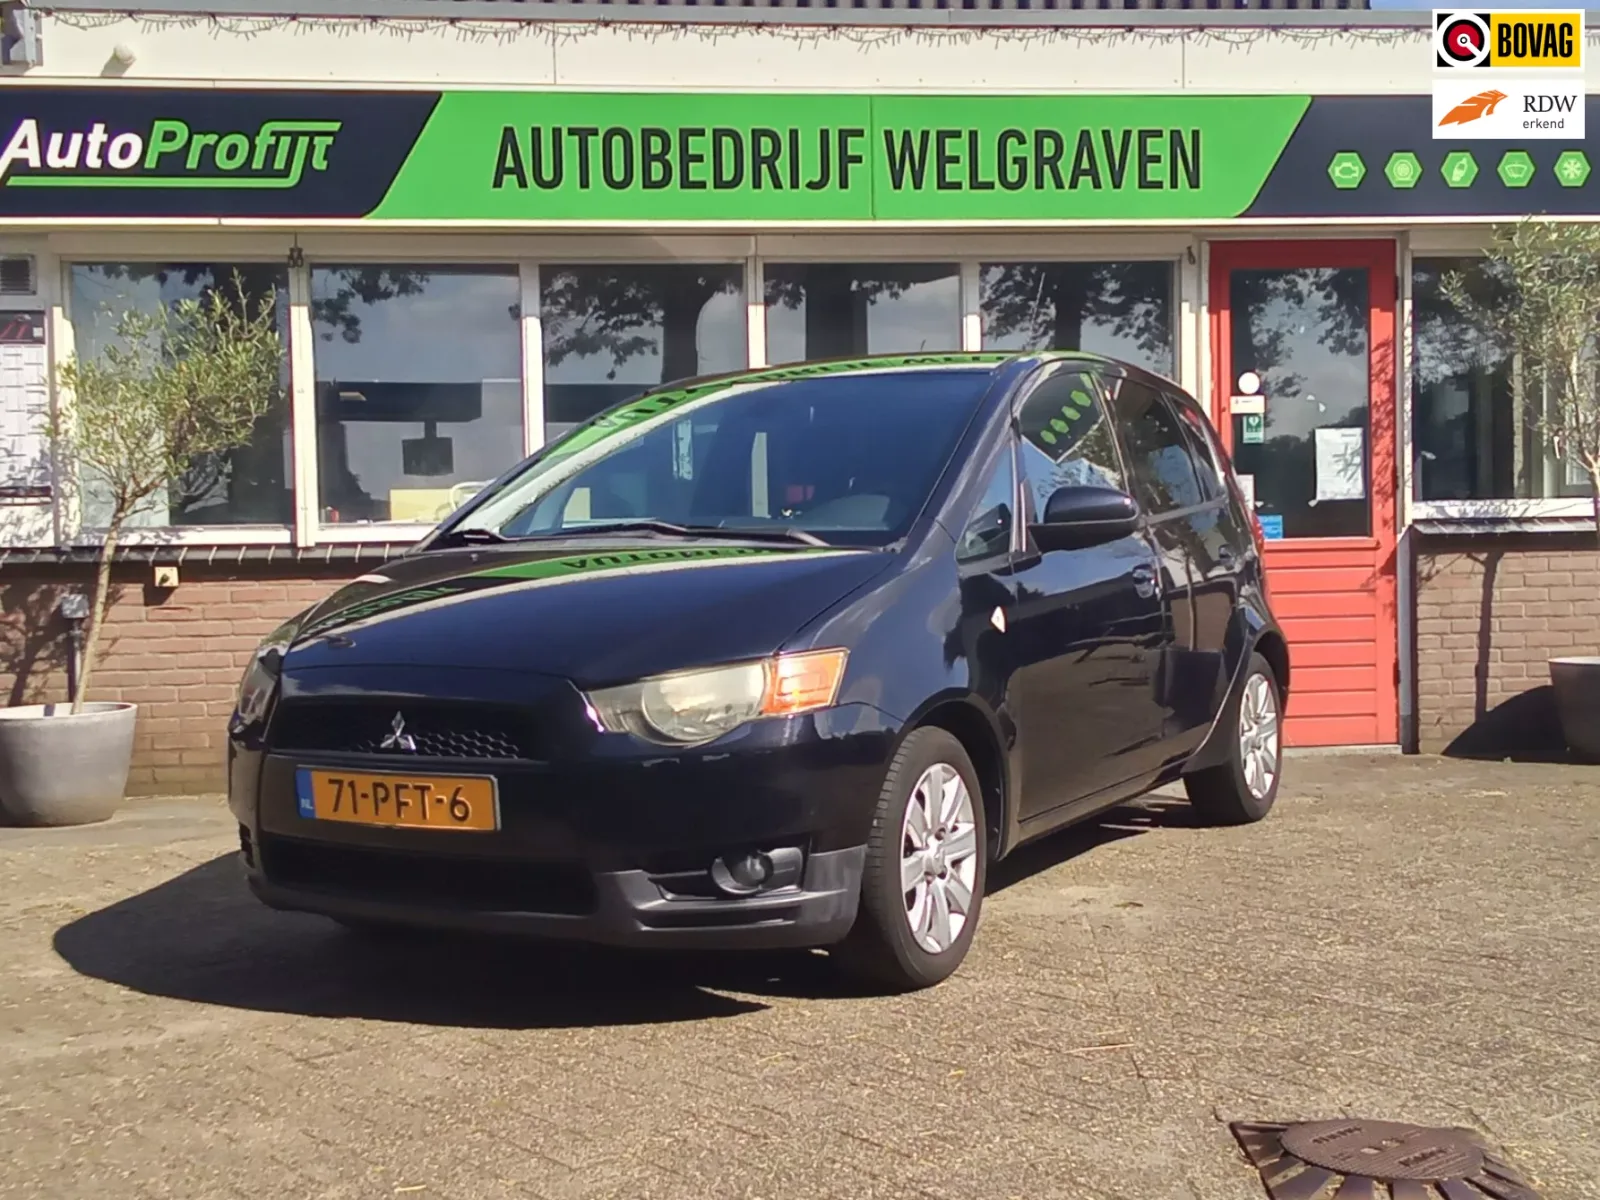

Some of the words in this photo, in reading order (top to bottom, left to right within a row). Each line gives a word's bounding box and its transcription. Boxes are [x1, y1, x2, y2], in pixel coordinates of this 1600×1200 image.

[0, 119, 342, 187] AutoProfijt
[492, 126, 864, 190] AUTOBEDRIJF
[883, 129, 1201, 190] WELGRAVEN
[301, 798, 313, 810] NL
[328, 778, 472, 823] 71-PFT-6
